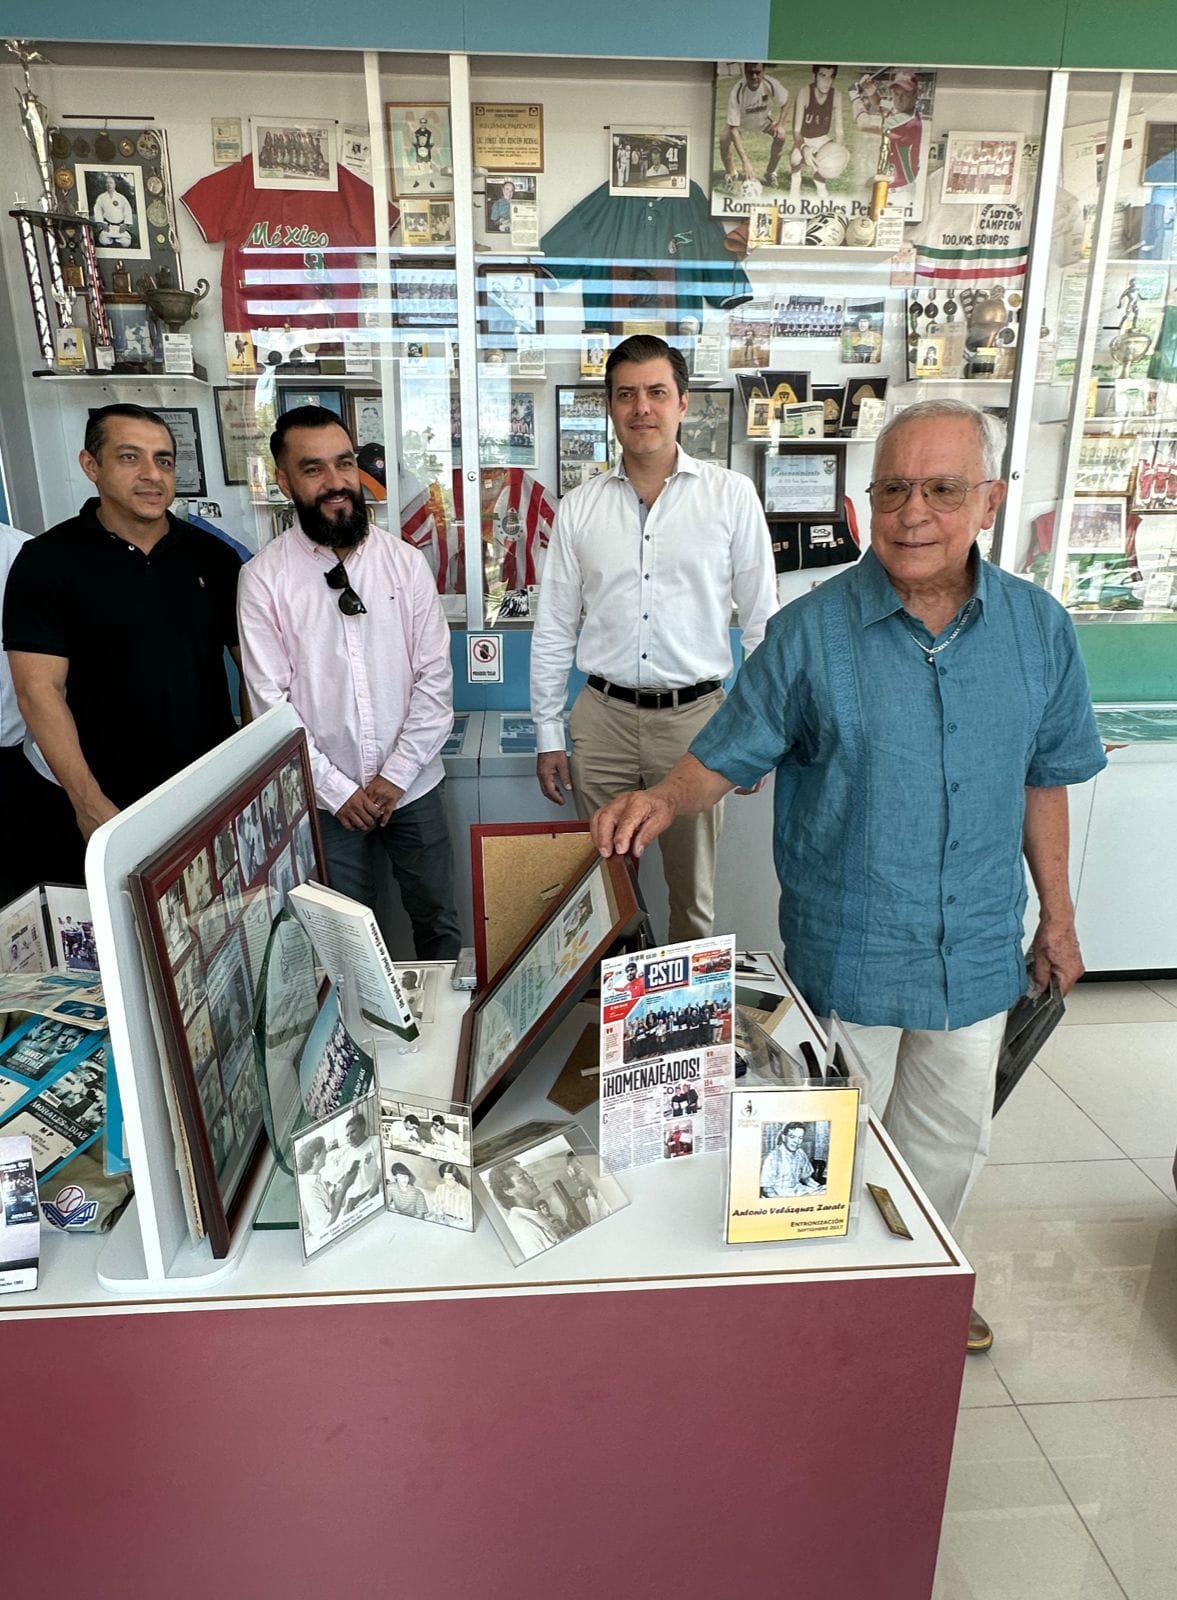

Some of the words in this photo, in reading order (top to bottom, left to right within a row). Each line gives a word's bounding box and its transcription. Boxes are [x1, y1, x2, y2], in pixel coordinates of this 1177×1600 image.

[240, 221, 329, 248] México
[30, 1100, 68, 1127] MORALES
[731, 1207, 768, 1218] Antonio
